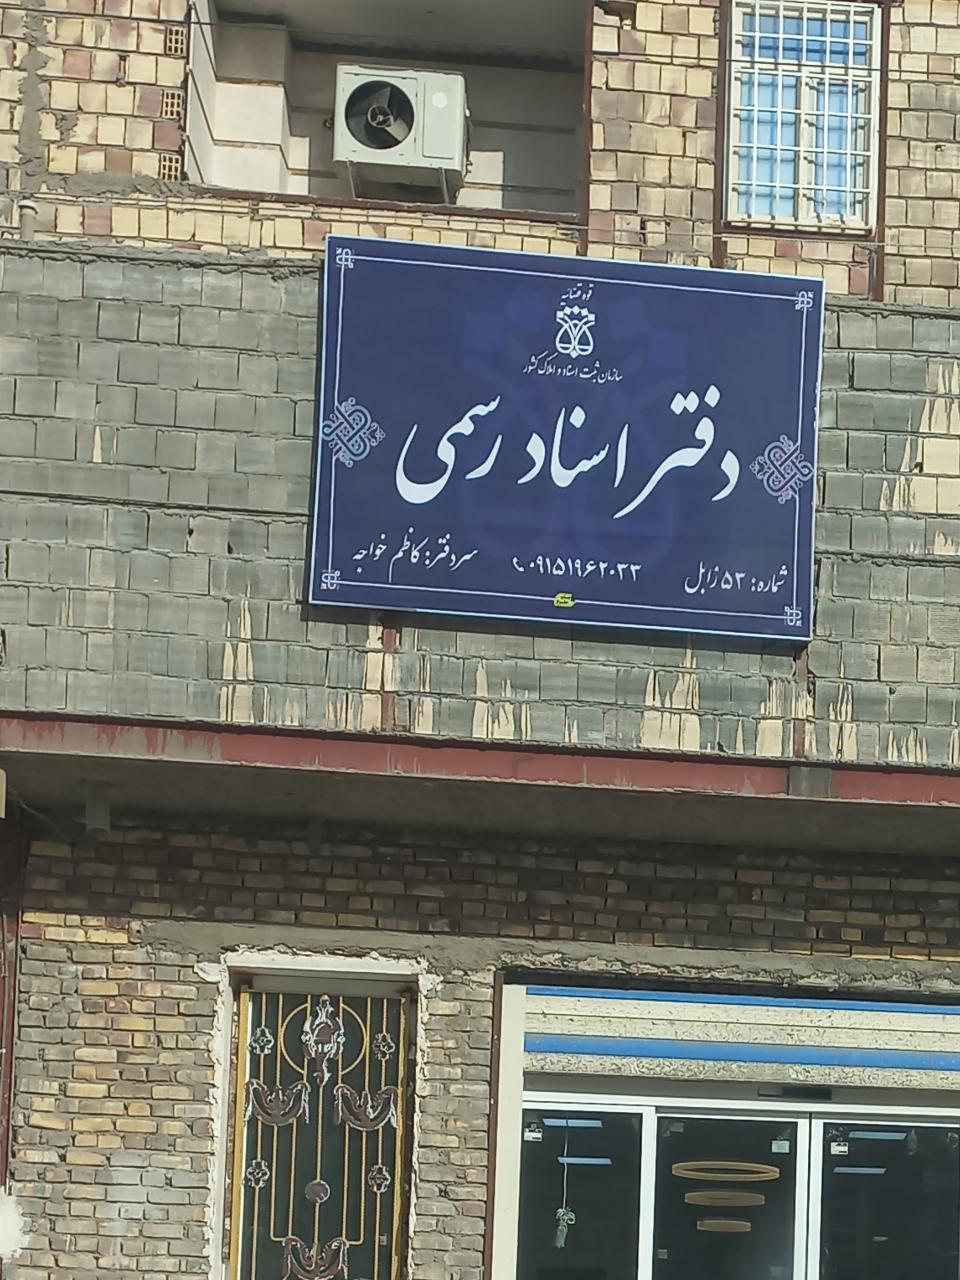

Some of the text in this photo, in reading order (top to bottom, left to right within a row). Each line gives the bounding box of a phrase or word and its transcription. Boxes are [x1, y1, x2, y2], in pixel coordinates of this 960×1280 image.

[581, 283, 594, 301] قوه
[522, 350, 549, 374] کشور
[537, 352, 559, 375] املاک
[562, 364, 578, 376] اسناد
[579, 360, 602, 383] ثبت
[597, 367, 623, 383] سازمان
[395, 384, 741, 519] دفتر اسناد رسمی
[352, 533, 388, 573] خواجه
[388, 526, 430, 584] کاظم
[529, 555, 642, 581] ۰۹۱۵۱۹۶۲۰۳۳
[684, 560, 720, 594] زابل
